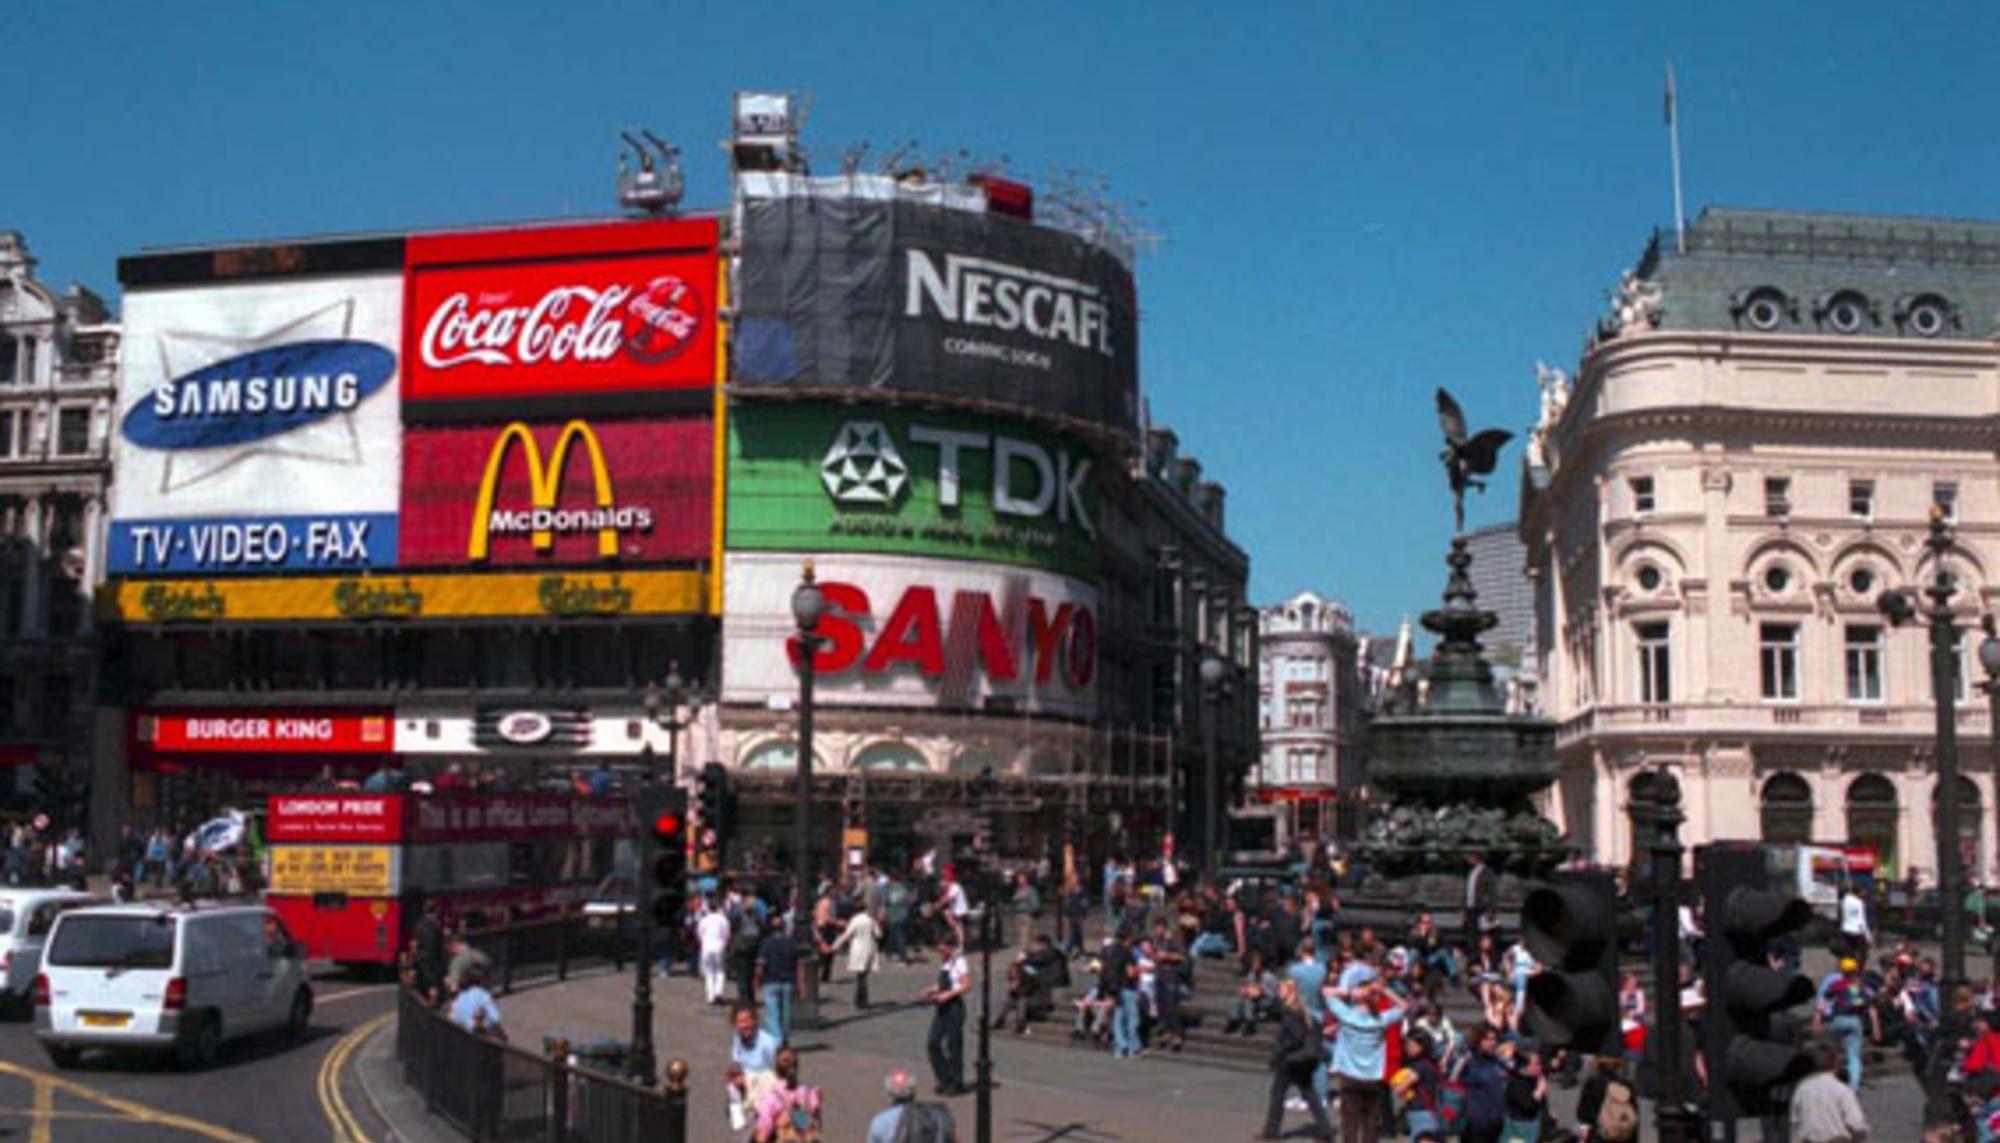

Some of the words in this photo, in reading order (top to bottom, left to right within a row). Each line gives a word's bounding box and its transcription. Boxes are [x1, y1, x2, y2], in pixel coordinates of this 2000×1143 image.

[153, 373, 358, 417] SAMSUNG
[909, 424, 1096, 542] TDK
[489, 507, 653, 531] McDonald's
[786, 581, 1096, 690] SANYO
[186, 719, 270, 740] BURGER
[275, 718, 333, 740] KING
